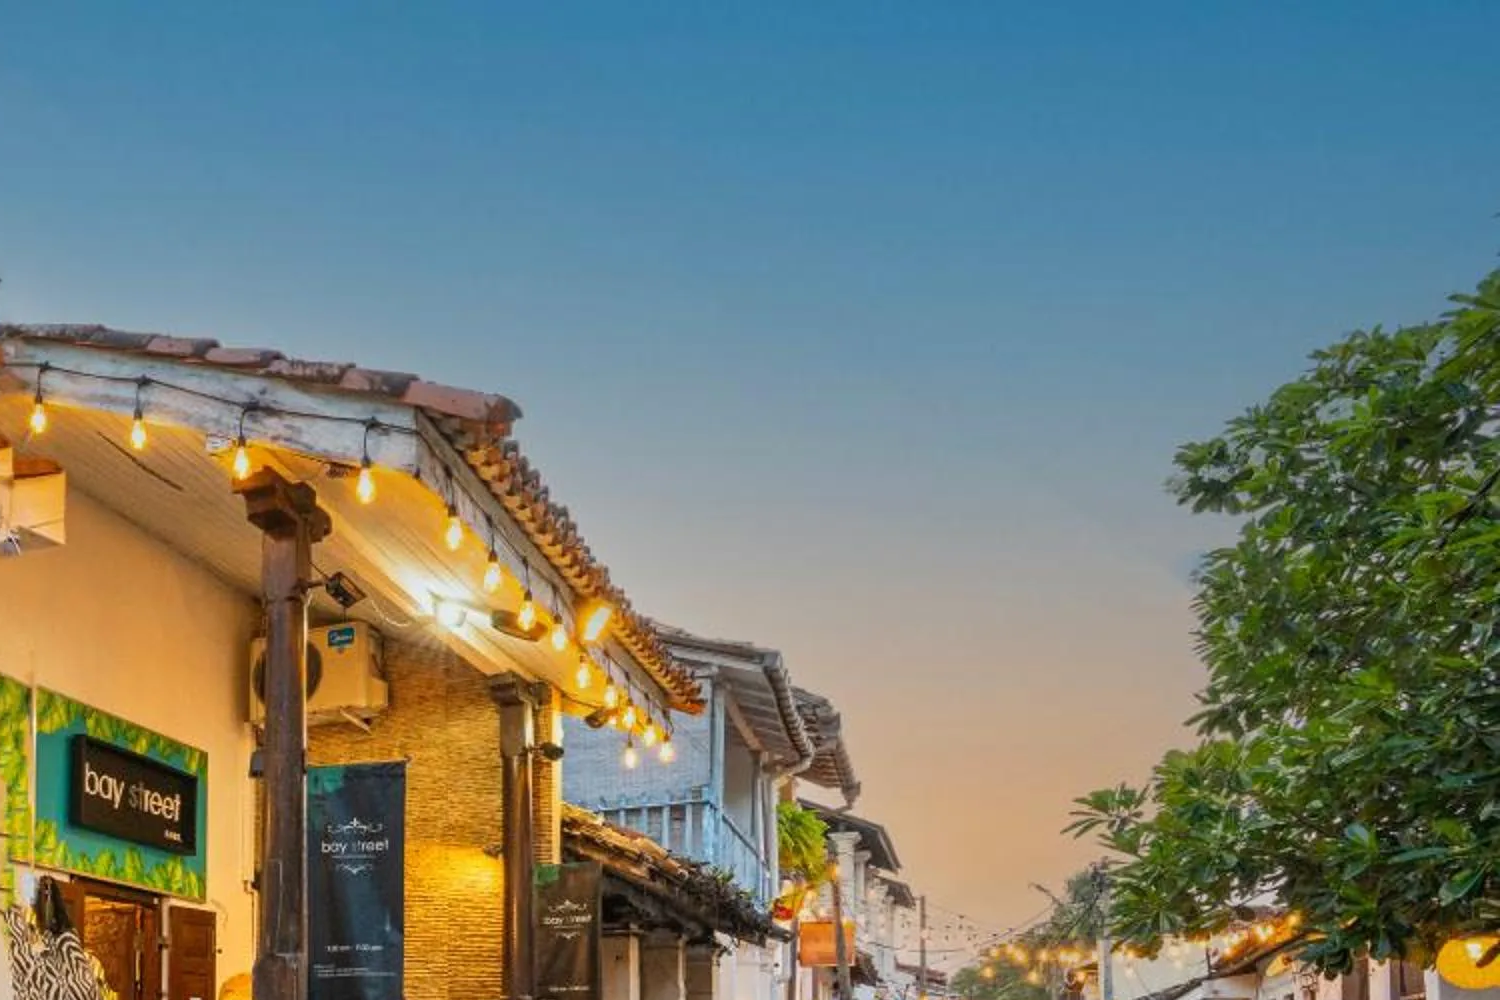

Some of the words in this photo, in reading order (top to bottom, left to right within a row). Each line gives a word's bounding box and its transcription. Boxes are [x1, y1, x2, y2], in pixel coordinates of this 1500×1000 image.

[84, 761, 125, 810] bay
[128, 781, 181, 822] street
[321, 840, 347, 855] bay
